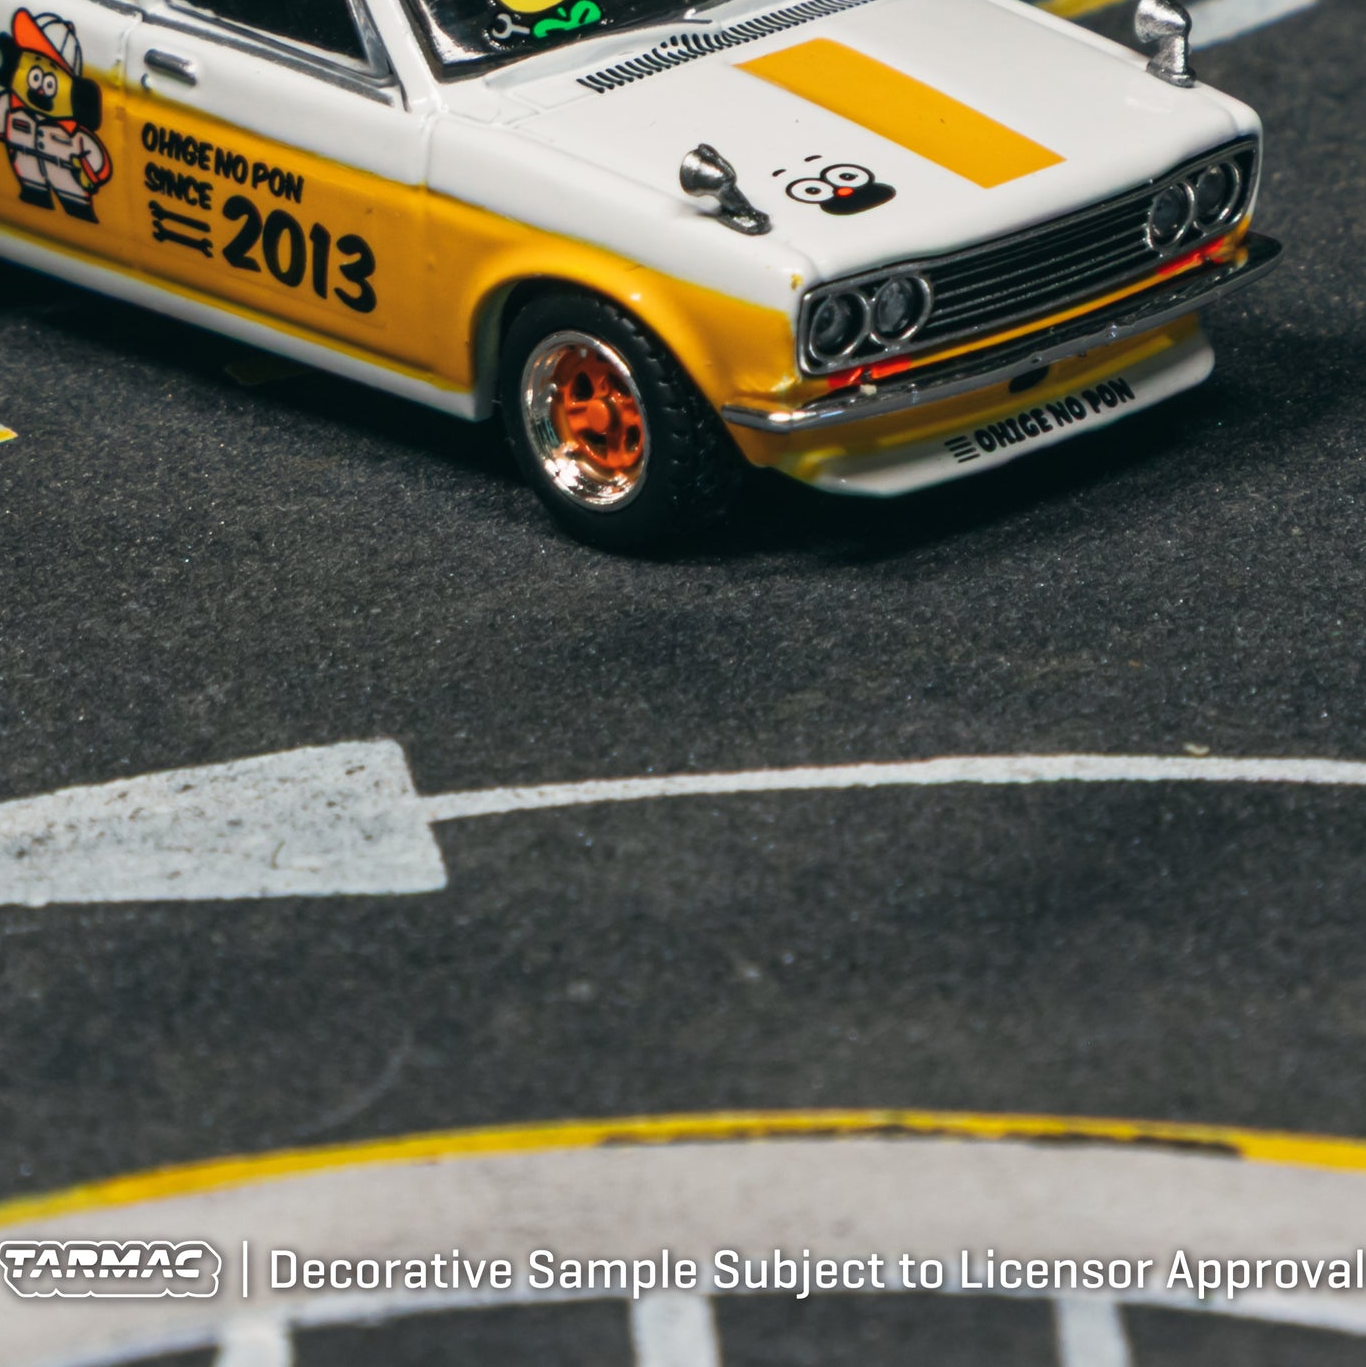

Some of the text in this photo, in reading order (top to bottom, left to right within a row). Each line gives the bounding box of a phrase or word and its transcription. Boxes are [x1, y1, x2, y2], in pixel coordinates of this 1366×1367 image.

[141, 121, 305, 204] OHIGE NO PON
[144, 161, 214, 211] SINCE
[222, 195, 377, 314] 2013
[974, 377, 1136, 453] OHIGE NO PON
